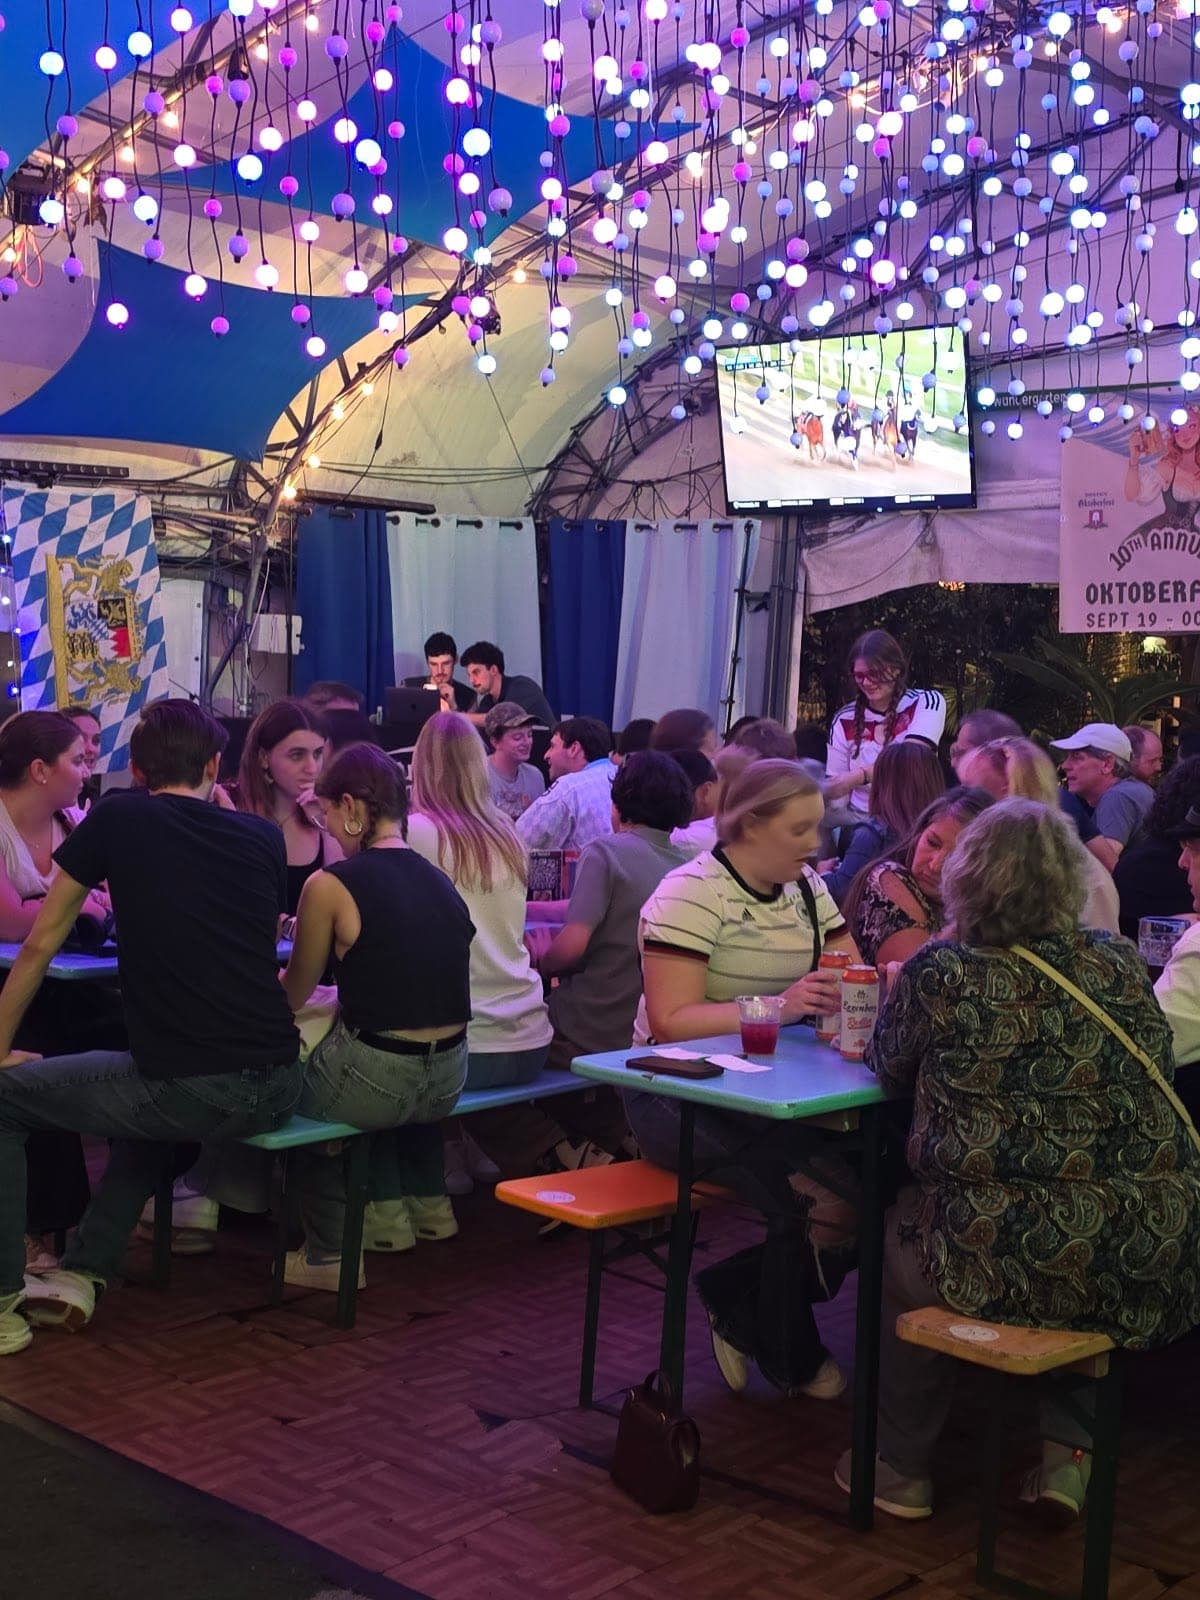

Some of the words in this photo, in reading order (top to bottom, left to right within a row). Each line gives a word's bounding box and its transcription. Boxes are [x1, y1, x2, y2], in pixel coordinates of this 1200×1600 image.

[1109, 537, 1142, 571] 10TH
[1151, 531, 1200, 560] ANNU
[1085, 579, 1200, 605] OKTOBERF
[1086, 611, 1129, 628] SEPT
[1137, 611, 1157, 628] 19
